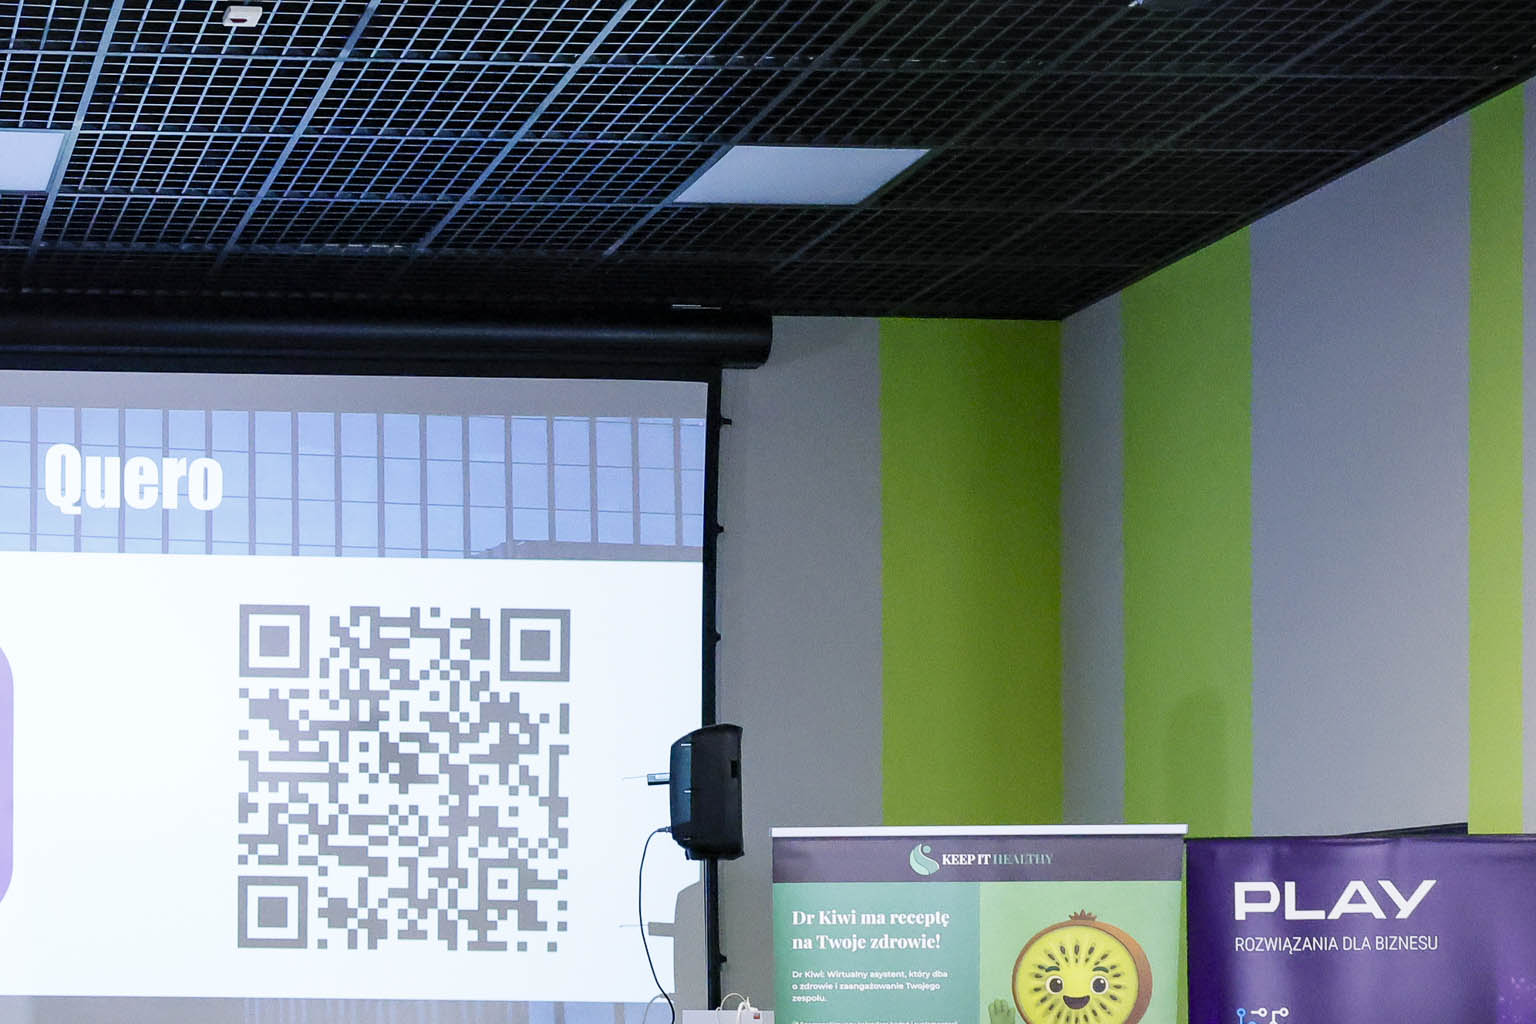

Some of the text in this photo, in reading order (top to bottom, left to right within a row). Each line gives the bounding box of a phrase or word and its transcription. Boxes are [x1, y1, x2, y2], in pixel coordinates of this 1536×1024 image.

[44, 444, 223, 515] Quero
[942, 854, 1054, 865] KEEP IT HEALTHY
[1234, 879, 1438, 920] PLAY
[792, 909, 951, 928] Dr Kiwi ma receptę
[792, 933, 941, 952] na Twoje zdrowie!
[1235, 936, 1439, 955] ROZWIĄZANIA DLA BIZNESU
[792, 969, 948, 980] Dr Kiwi: Wirtualny asystent, który dba
[799, 981, 833, 990] zdrowie
[839, 981, 904, 992] zaangażowanie
[906, 982, 941, 992] Twojego
